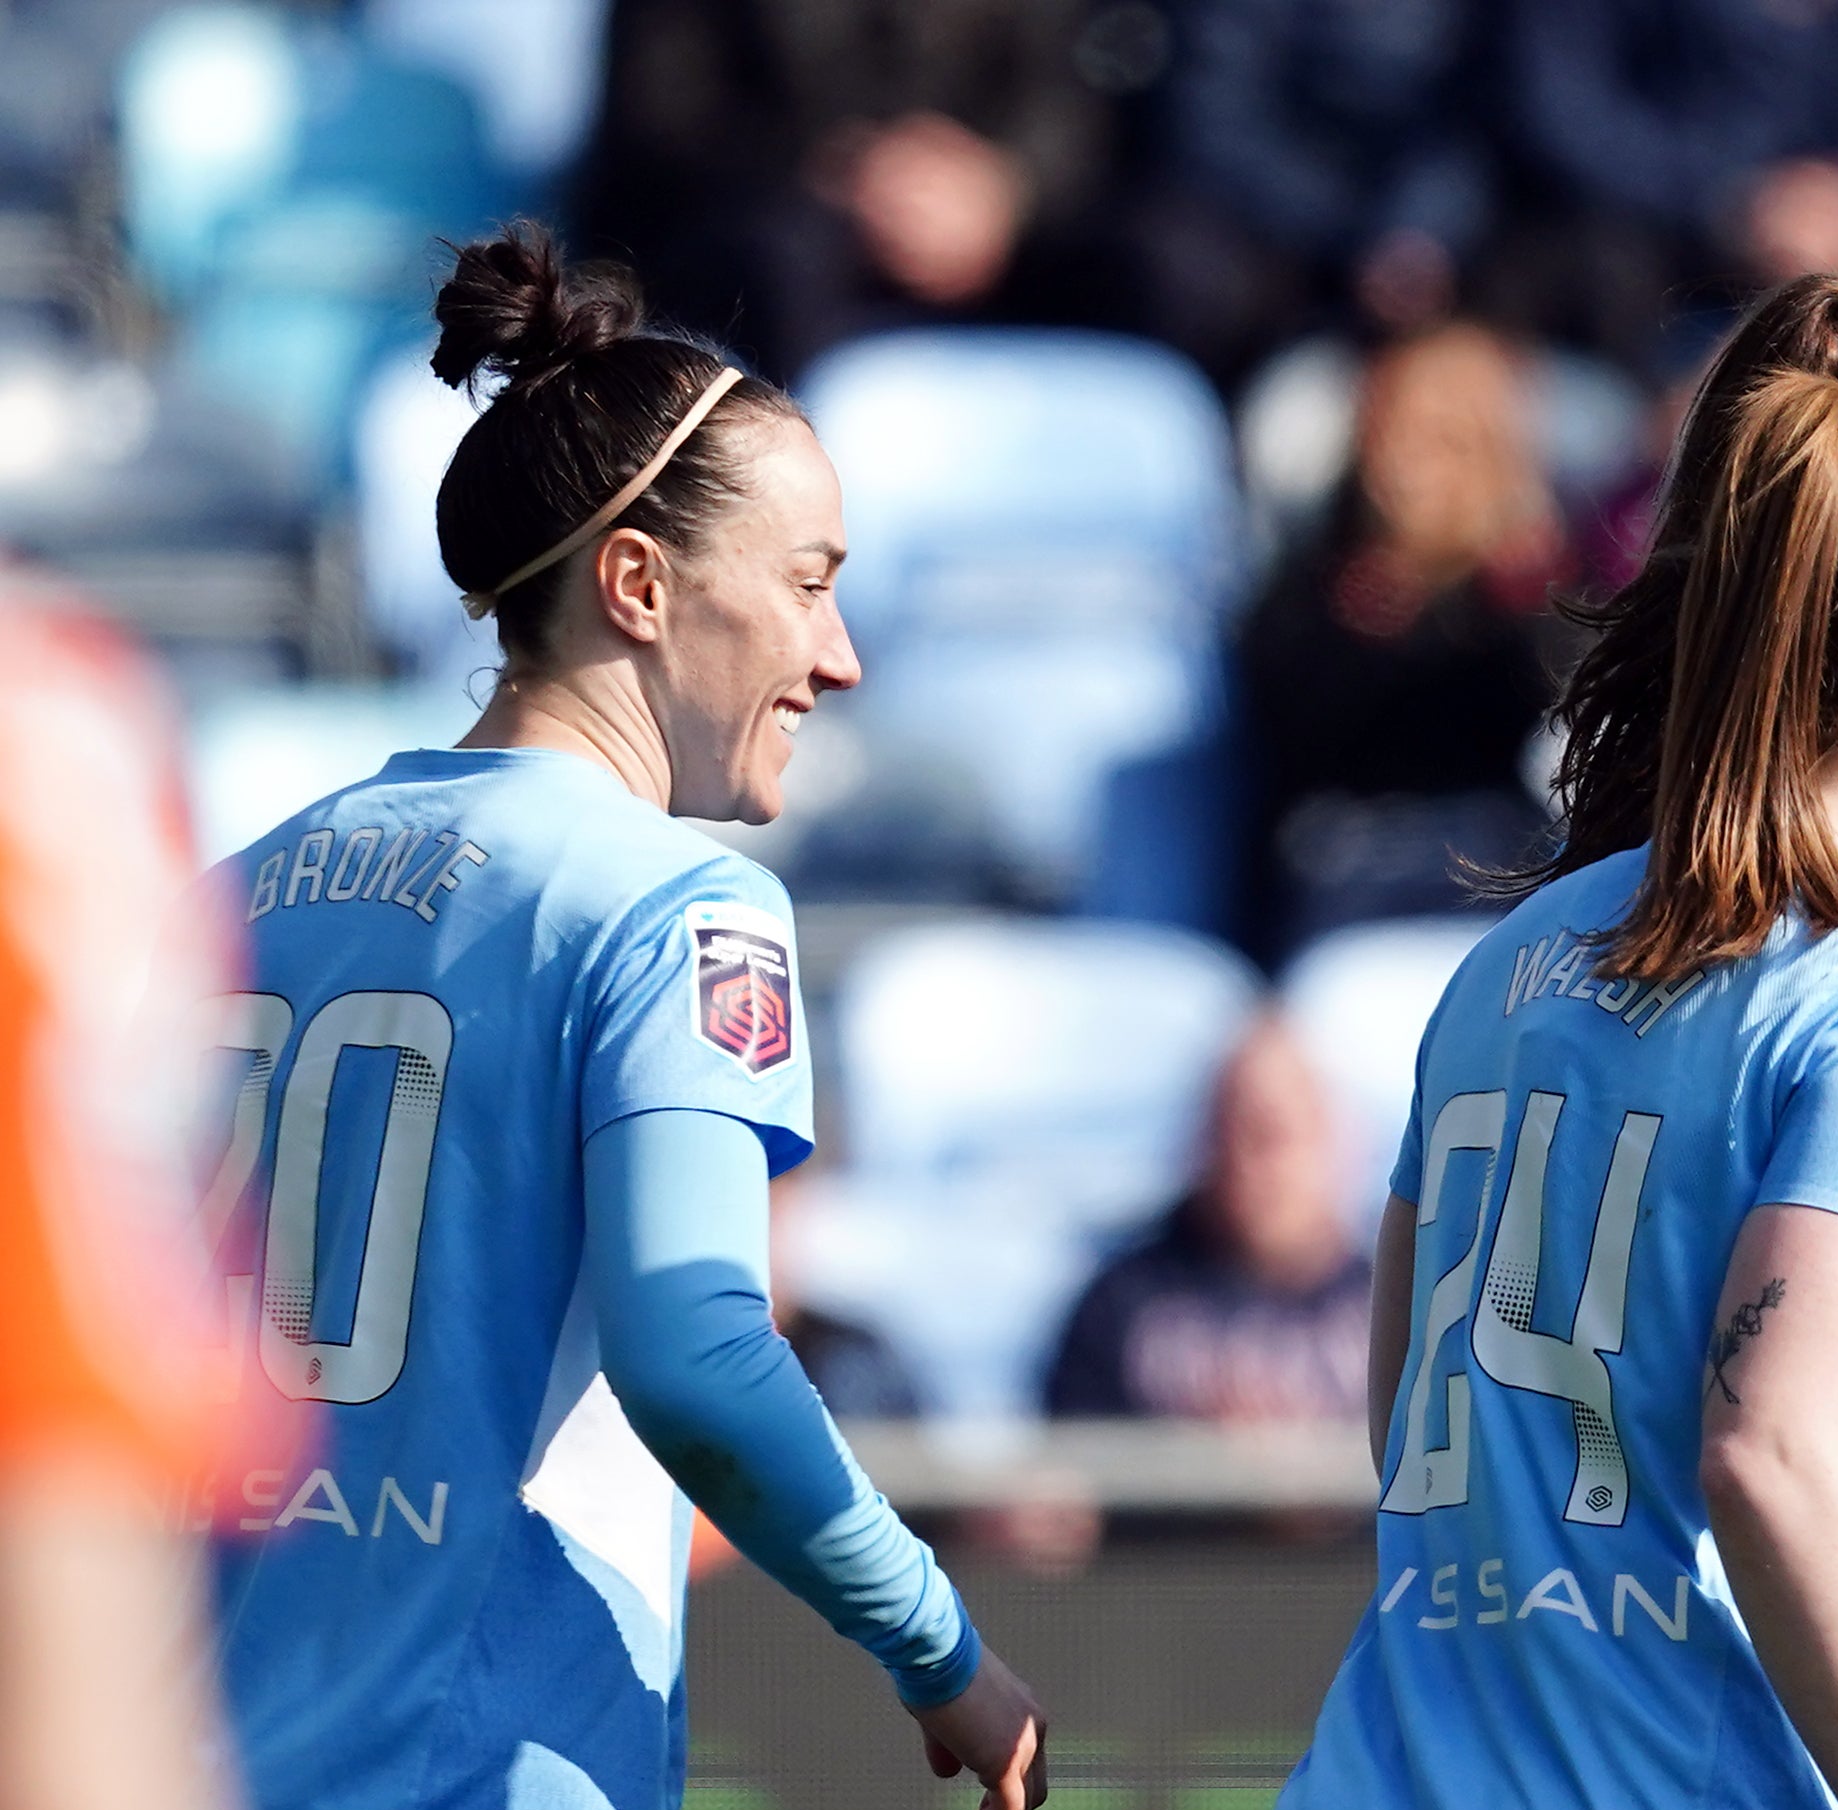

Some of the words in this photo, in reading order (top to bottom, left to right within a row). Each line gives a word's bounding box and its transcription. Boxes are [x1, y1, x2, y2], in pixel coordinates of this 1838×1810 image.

[248, 827, 491, 925] BRONZE
[1380, 1089, 1663, 1527] 24
[1379, 1558, 1689, 1641] ISSAN
